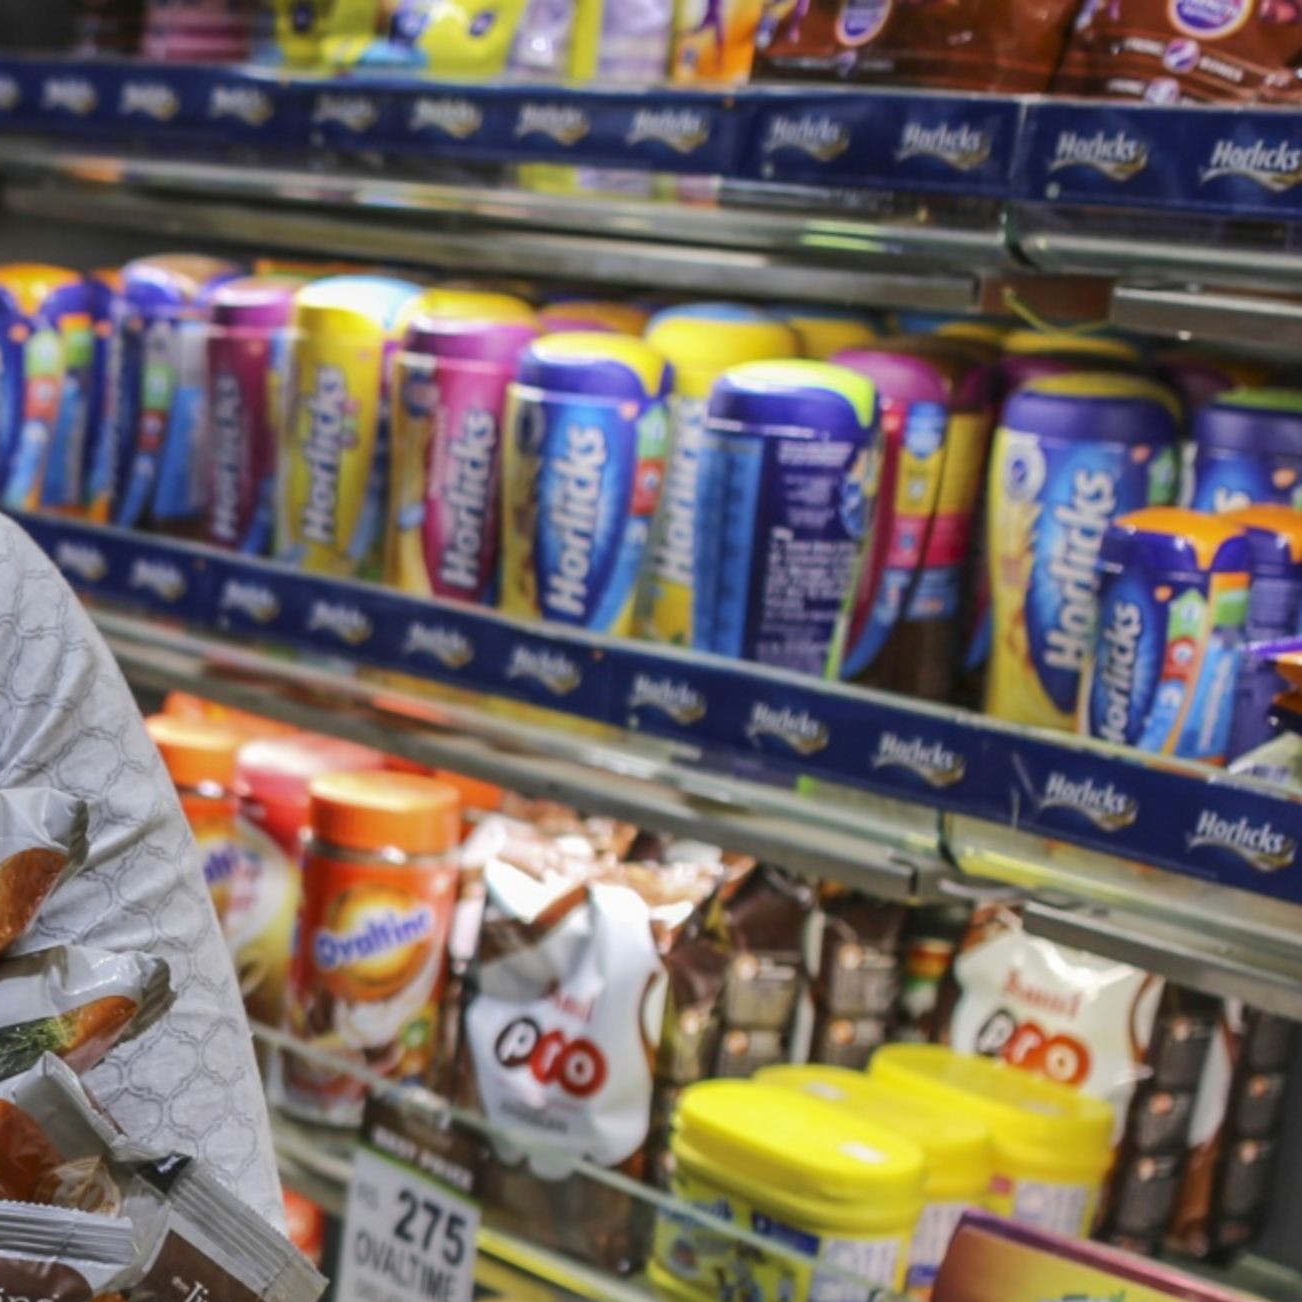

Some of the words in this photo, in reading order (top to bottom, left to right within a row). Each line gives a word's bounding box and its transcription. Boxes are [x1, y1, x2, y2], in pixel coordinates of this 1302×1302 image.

[902, 121, 984, 156] Horlicks
[1056, 130, 1139, 164] Horlicks
[1210, 139, 1300, 173] Horlicks
[302, 366, 345, 543] Horlicks
[442, 407, 498, 588] Horlicks
[548, 425, 608, 616] Horlicks
[1044, 469, 1117, 671] Horlicks
[880, 732, 958, 771] Horlicks
[1046, 774, 1127, 813] Horlicks
[1198, 811, 1285, 855] Horlicks
[393, 1188, 468, 1267] 275
